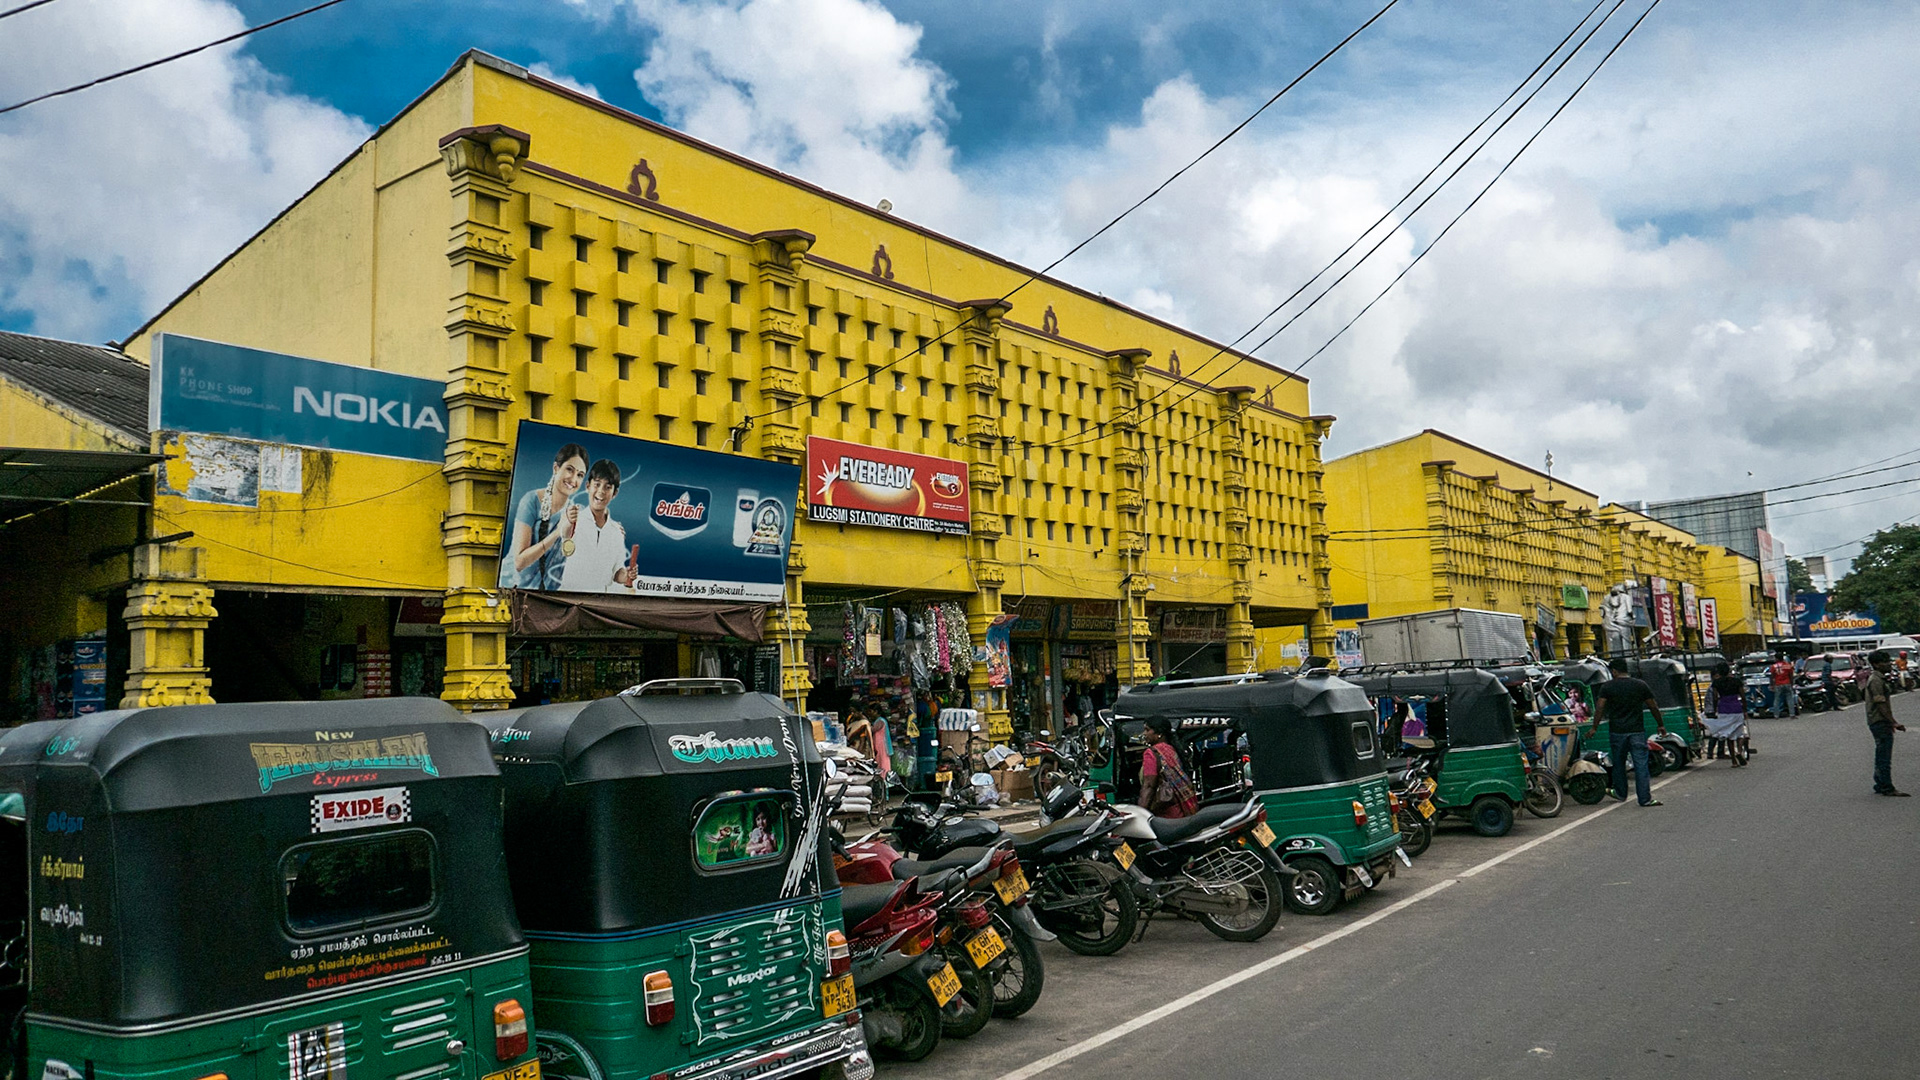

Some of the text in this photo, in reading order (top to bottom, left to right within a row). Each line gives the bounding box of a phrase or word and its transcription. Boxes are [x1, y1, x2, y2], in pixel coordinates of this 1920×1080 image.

[180, 377, 253, 396] PHONE SHOP
[293, 386, 446, 433] NOKIA
[839, 456, 915, 489] EVEREADY
[656, 500, 705, 520] அங்கர்
[813, 505, 849, 522] LUGSMI
[850, 510, 901, 528] STATIONERY
[903, 516, 934, 531] CENTRE
[637, 580, 671, 592] மோகன்
[674, 582, 707, 595] வர்த்தக
[708, 584, 745, 596] நிலையம்
[1659, 595, 1674, 640] Bata
[1704, 602, 1716, 640] Bata
[1182, 717, 1231, 726] RELAX
[498, 727, 531, 743] You
[668, 731, 778, 763] Thanu
[250, 731, 439, 794] JERUSALEM
[312, 771, 378, 787] Express
[322, 796, 385, 819] EXIDE
[983, 941, 1002, 961] 1376
[727, 965, 778, 987] Maxtor
[824, 993, 836, 1006] NP
[771, 1030, 811, 1046] adidas
[674, 1059, 721, 1078] adidas
[731, 1051, 808, 1080] adidas
